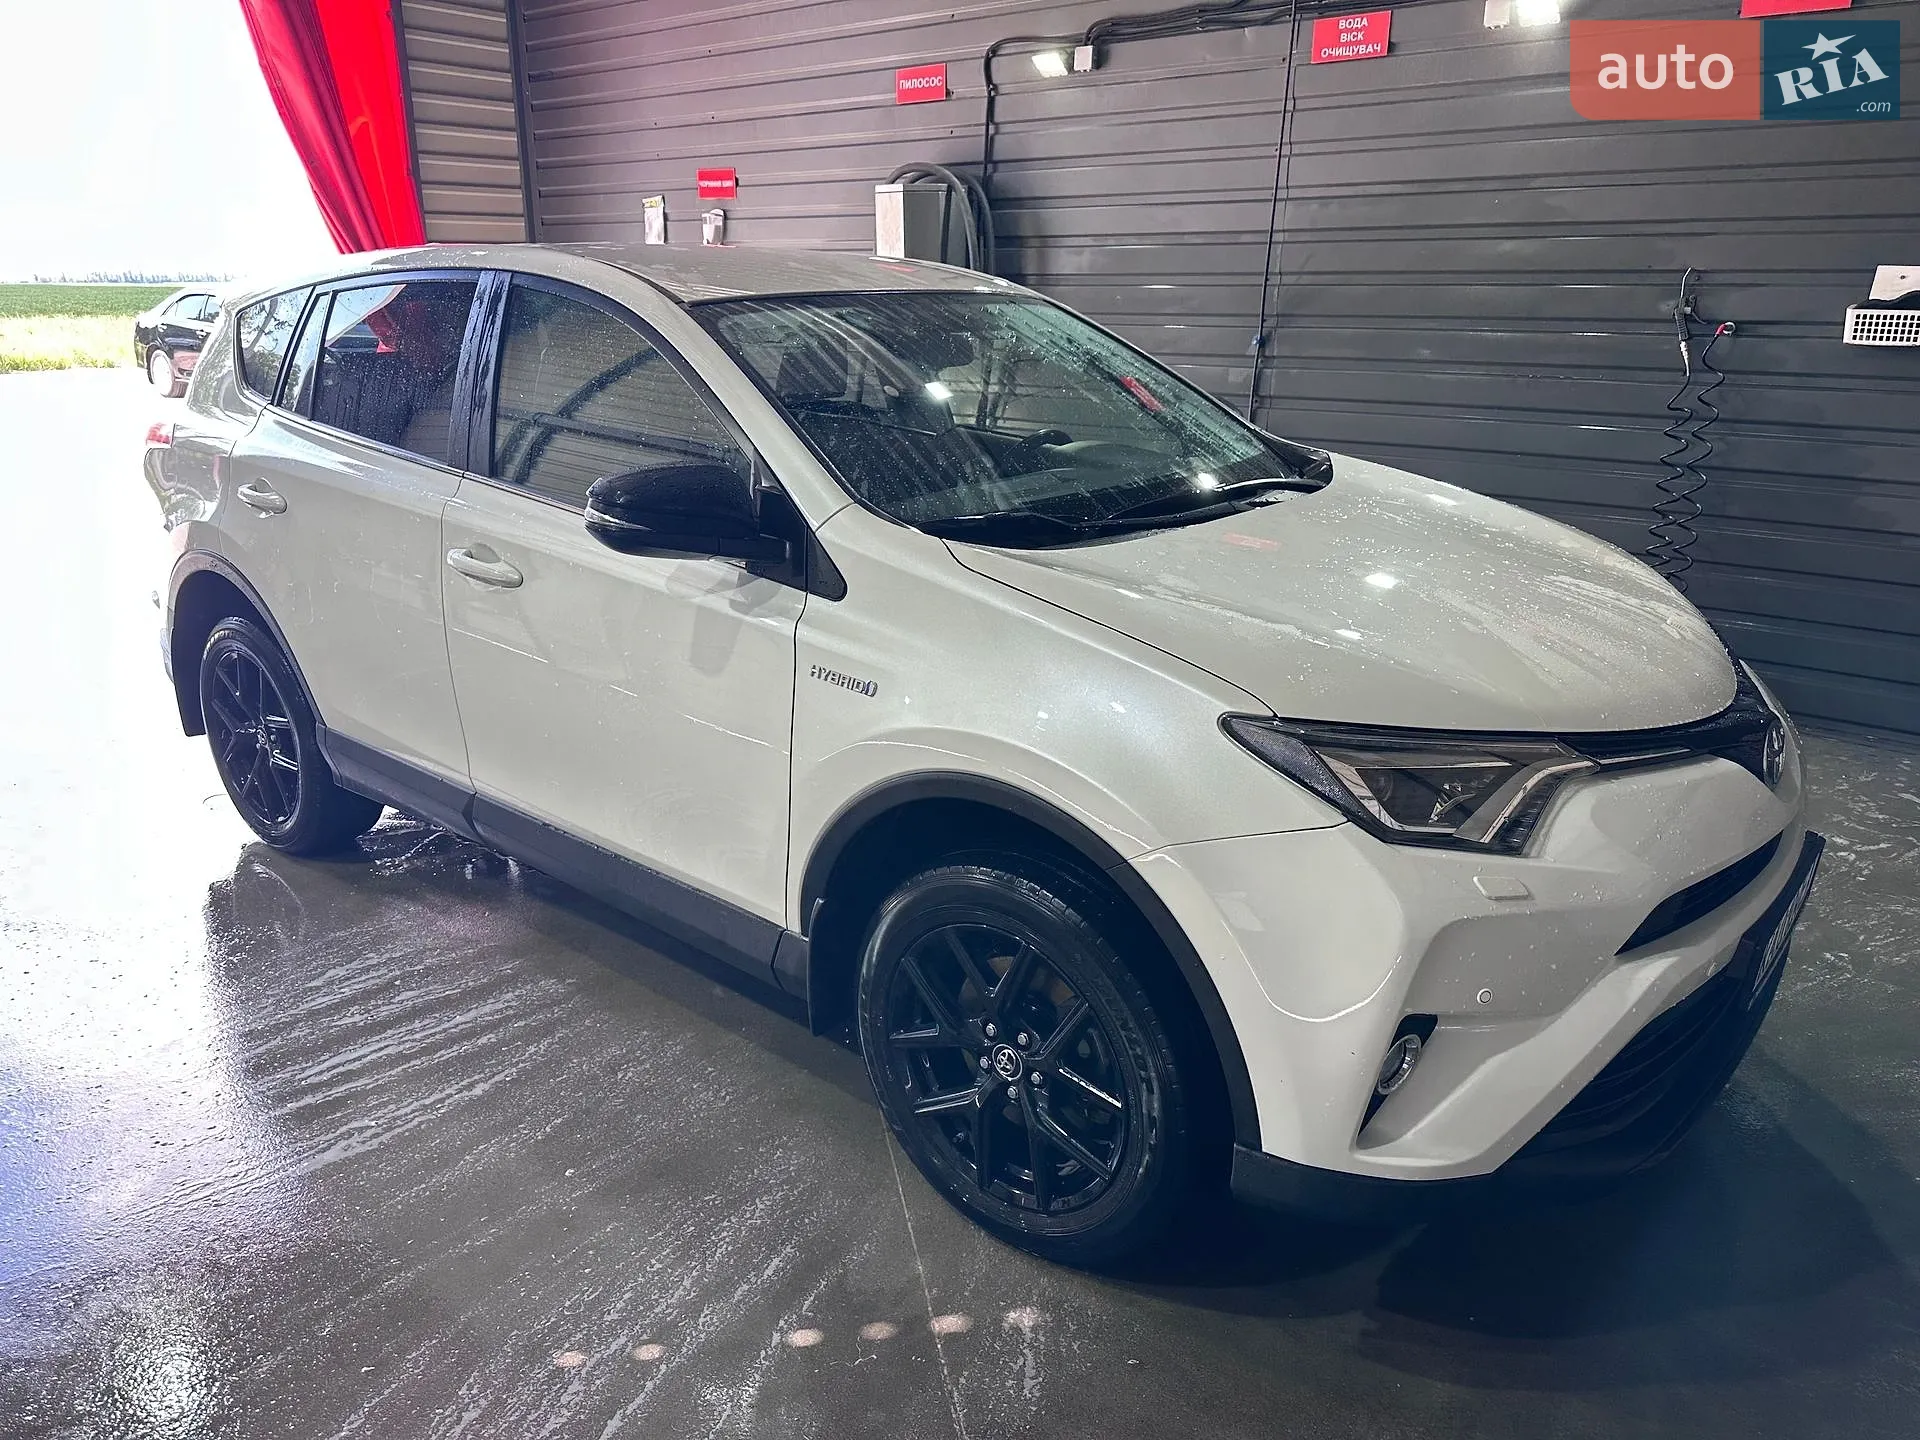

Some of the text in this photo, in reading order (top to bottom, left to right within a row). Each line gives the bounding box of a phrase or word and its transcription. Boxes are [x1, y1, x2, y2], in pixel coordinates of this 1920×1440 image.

[1338, 17, 1368, 30] ВОДА
[1340, 31, 1365, 43] ВІСК
[1320, 43, 1381, 58] ОЧИЩУВАЧ
[899, 76, 943, 90] ПИЛОСОС
[809, 664, 867, 694] HYBRID
